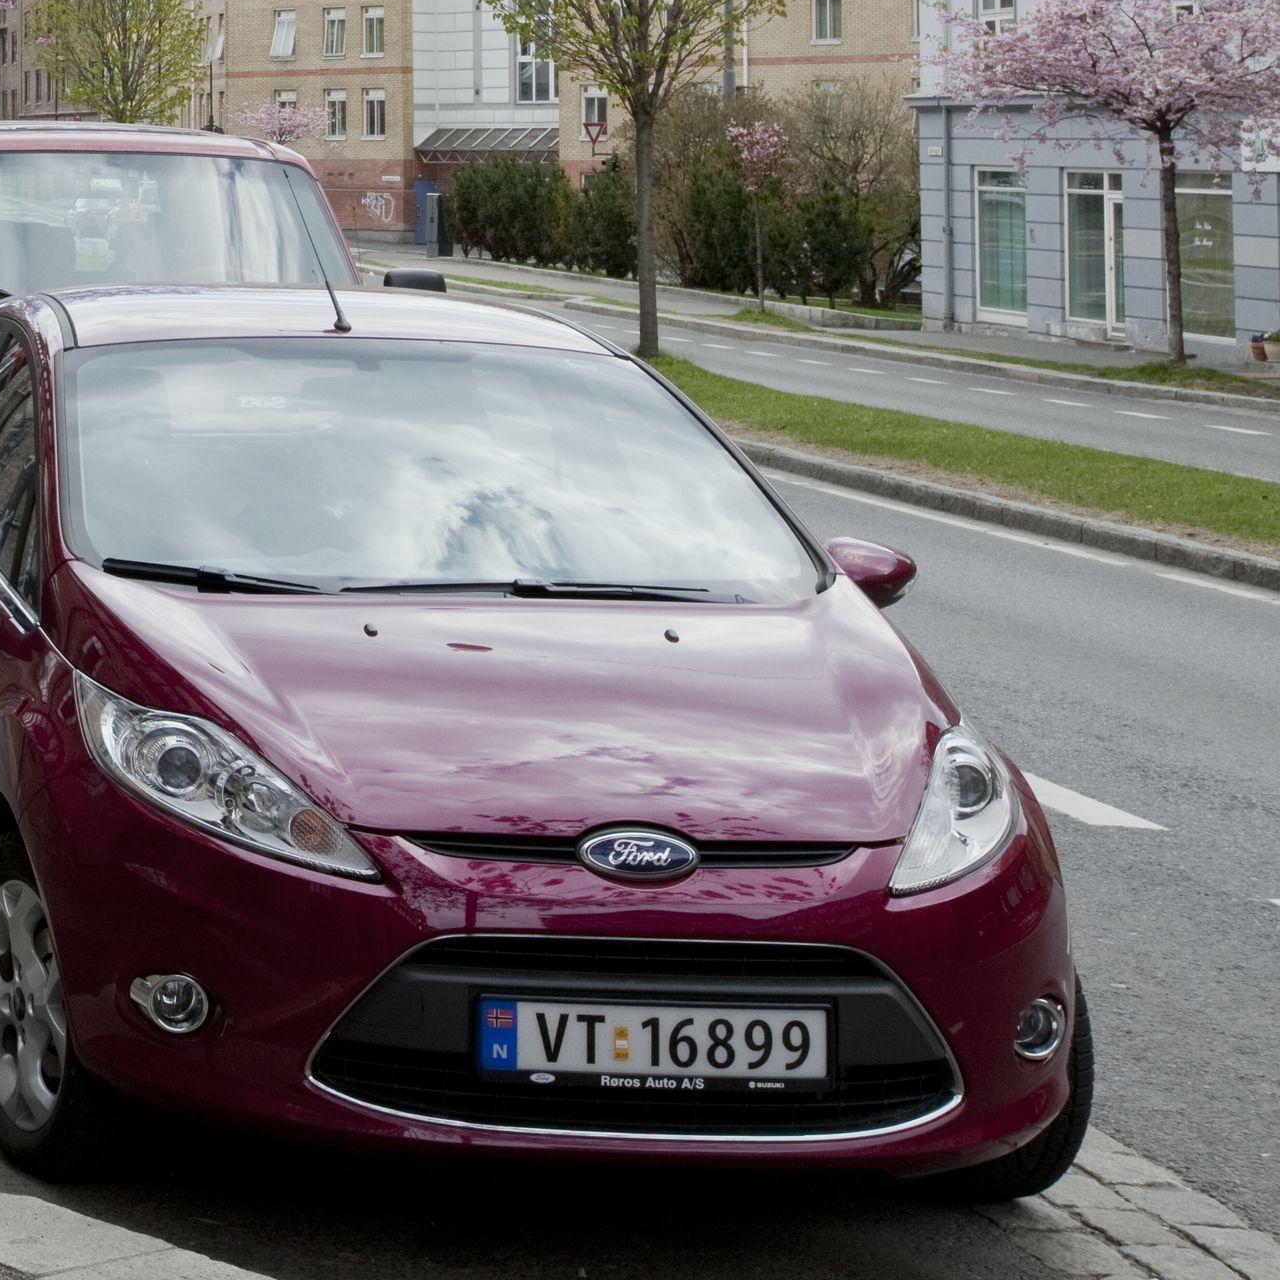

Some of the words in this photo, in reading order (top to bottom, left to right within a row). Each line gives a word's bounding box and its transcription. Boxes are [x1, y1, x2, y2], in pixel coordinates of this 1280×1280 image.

[608, 839, 671, 867] Ford
[535, 1012, 606, 1065] VT
[641, 1017, 811, 1072] 16899
[491, 1043, 508, 1059] N
[600, 1075, 641, 1088] Røros
[645, 1076, 677, 1089] Auto
[681, 1077, 705, 1090] A/S
[756, 1081, 785, 1089] SUZUKI
